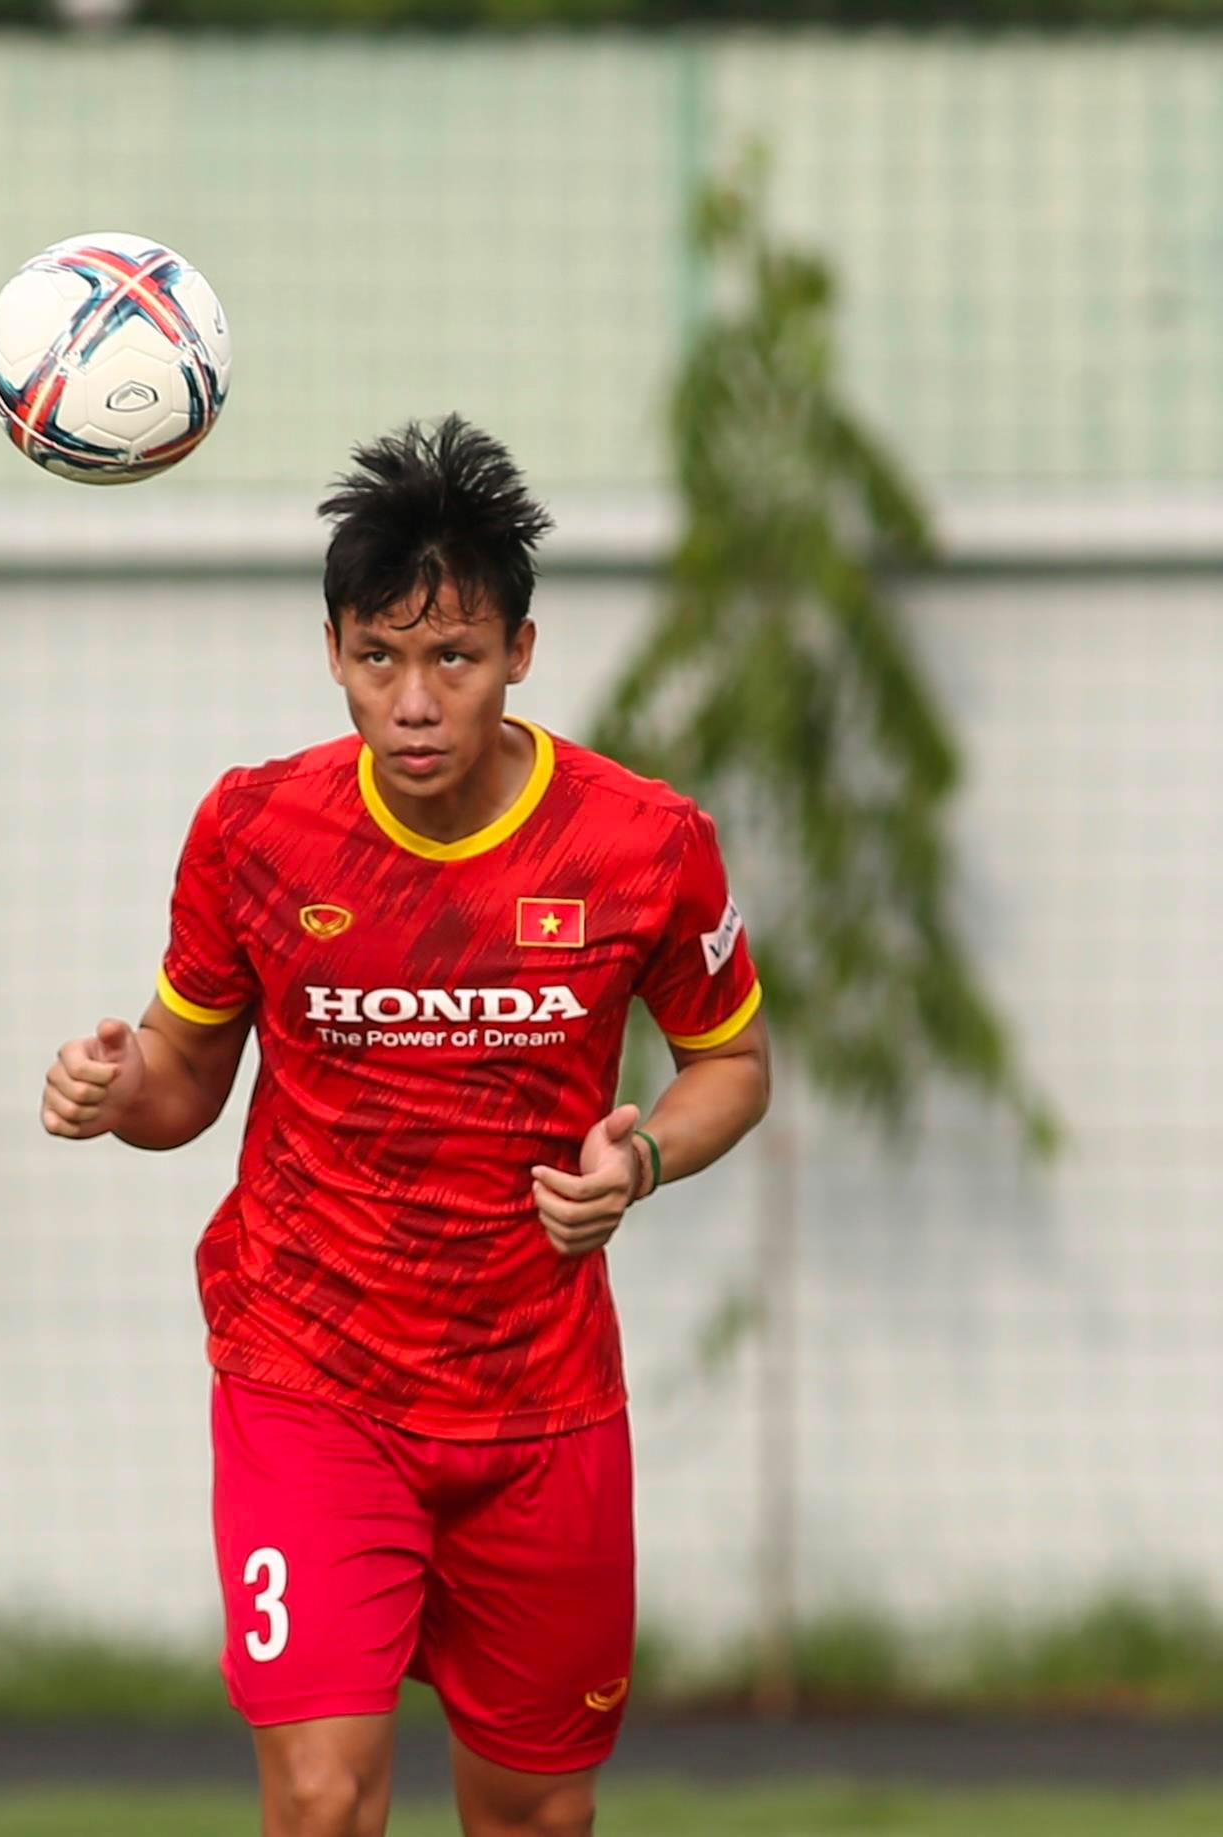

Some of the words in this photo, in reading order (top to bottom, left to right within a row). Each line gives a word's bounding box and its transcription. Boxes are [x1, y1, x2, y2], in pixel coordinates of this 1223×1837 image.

[305, 987, 588, 1022] HONDA
[317, 1027, 362, 1047] The
[366, 1029, 445, 1048] Power
[450, 1029, 479, 1048] of
[484, 1029, 565, 1048] Dream
[243, 1547, 289, 1663] 3
